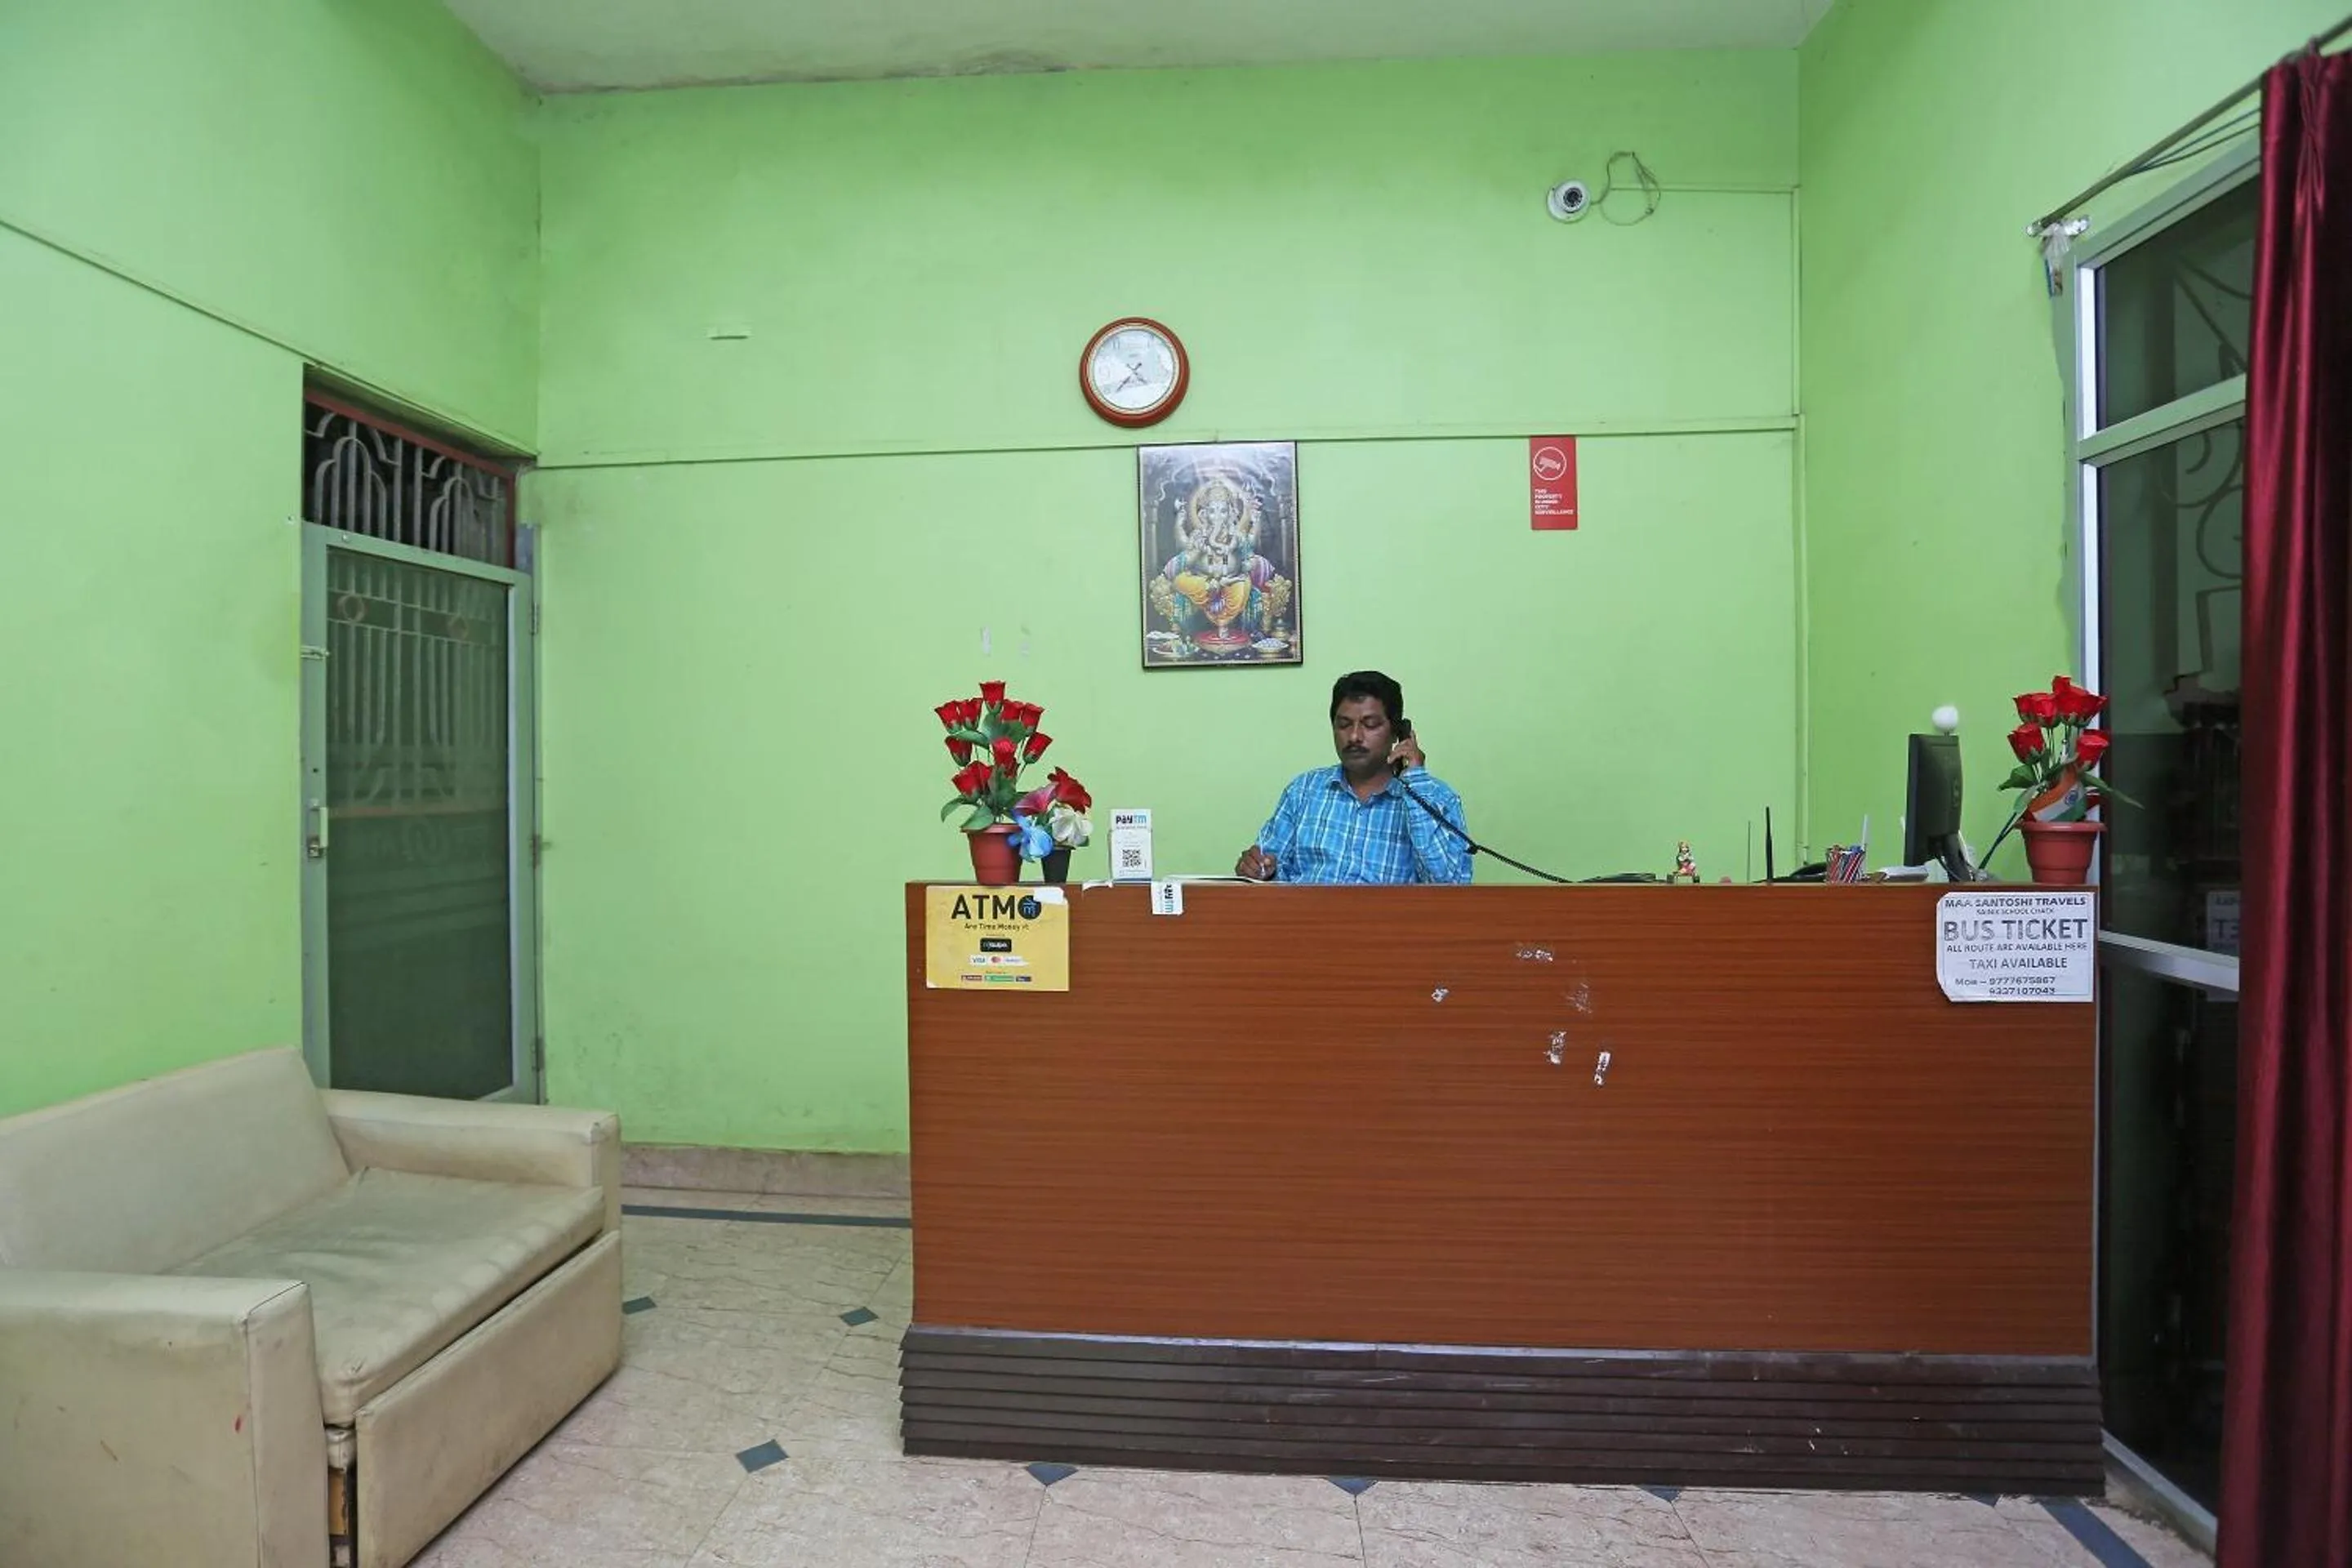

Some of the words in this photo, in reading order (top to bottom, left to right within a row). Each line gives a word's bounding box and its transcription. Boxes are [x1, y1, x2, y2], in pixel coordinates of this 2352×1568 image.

[1976, 898, 2033, 907] SANTOSHI
[2035, 897, 2086, 906] TRAVELS
[1944, 920, 1995, 941] BUS
[2001, 919, 2088, 940] TICKET
[1947, 944, 1962, 953] ALL
[1964, 944, 1993, 952] ROUTE
[2014, 942, 2063, 951] AVAILABLE
[2065, 942, 2088, 951] HERE
[1969, 959, 1998, 969] TAXI
[2000, 957, 2068, 969] AVAILABLE
